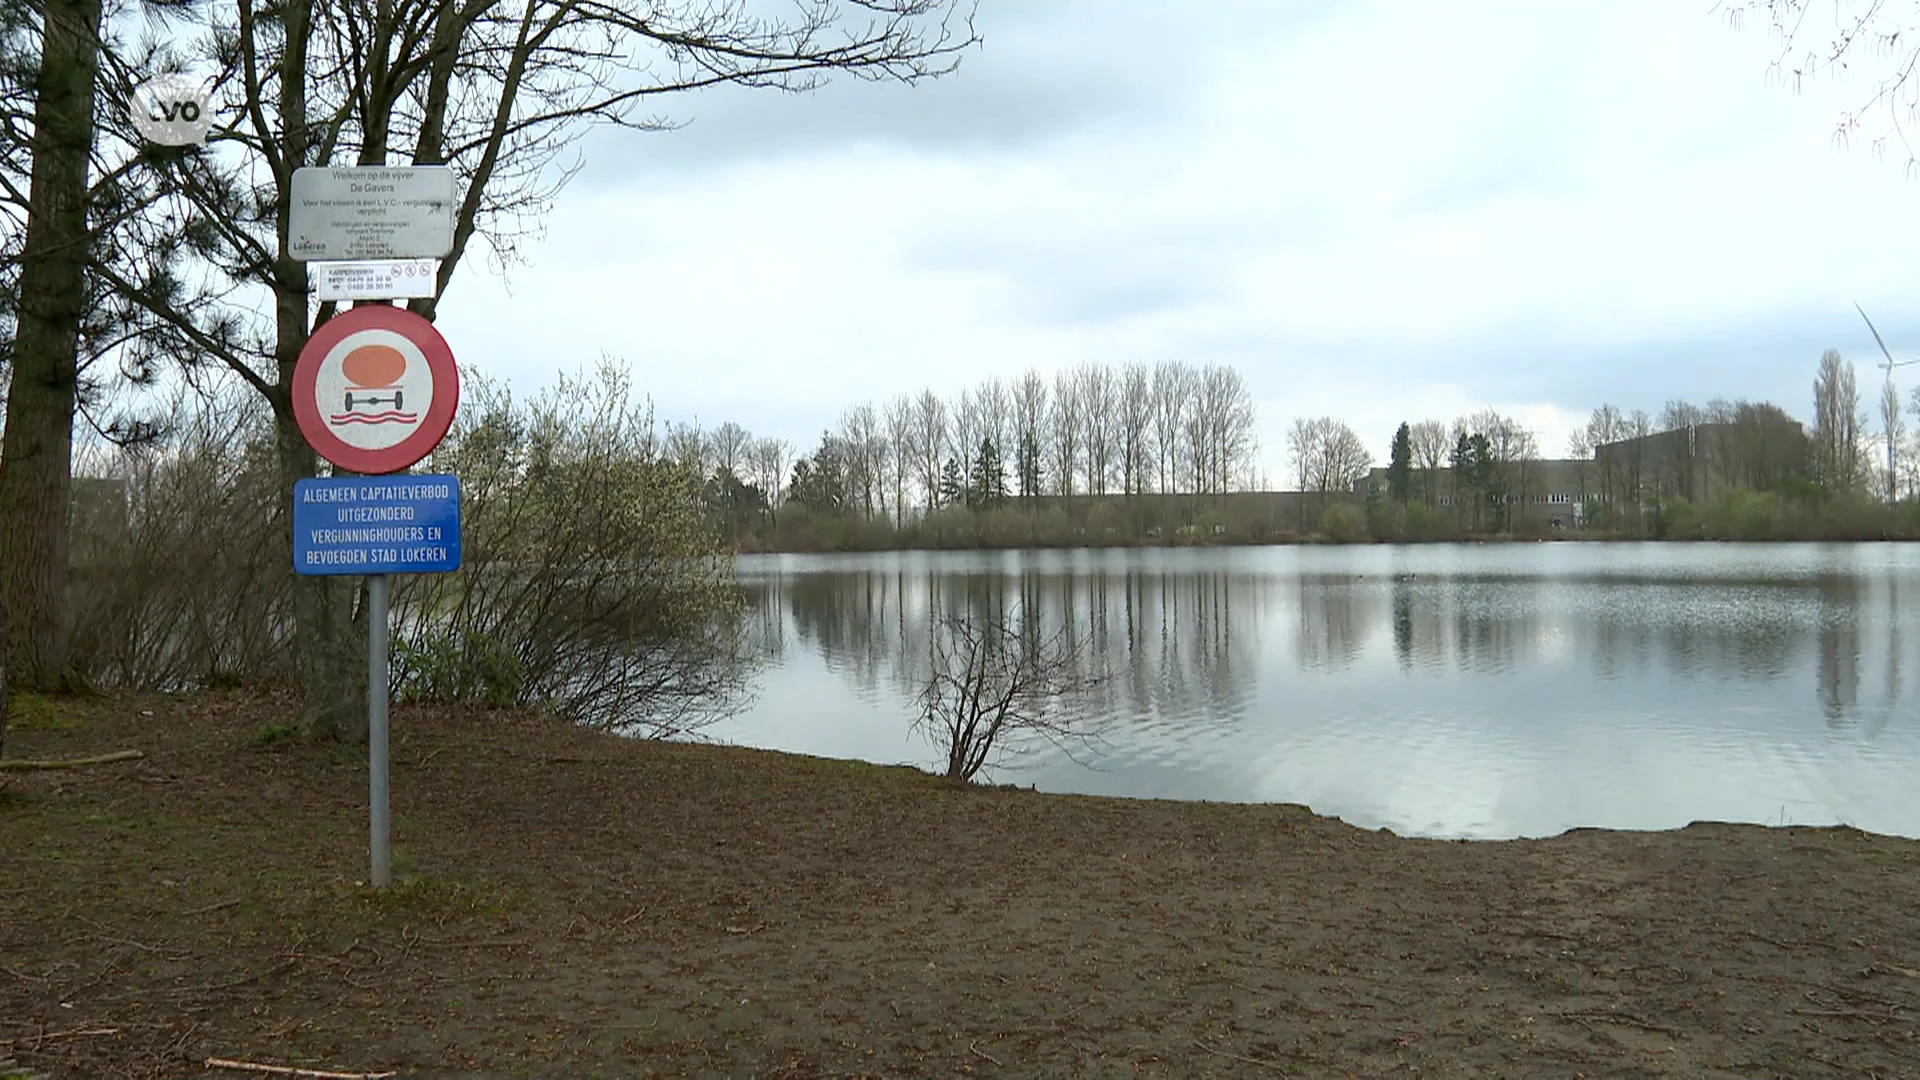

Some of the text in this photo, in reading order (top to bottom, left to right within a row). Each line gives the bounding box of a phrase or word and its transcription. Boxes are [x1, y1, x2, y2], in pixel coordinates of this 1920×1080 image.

[332, 171, 414, 182] Welkom op de vijver
[350, 183, 394, 193] De Gavers
[303, 199, 319, 207] Voor
[320, 199, 331, 207] het
[332, 199, 354, 207] vissen
[363, 199, 376, 207] een
[356, 208, 386, 217] verplicht
[303, 484, 449, 503] ALGEMEEN CAPTATIEVERBOD
[337, 507, 415, 523] UITGEZONDERD
[311, 526, 442, 544] VERGUNNINGHOUDERS EN
[306, 547, 447, 565] BEVOEGDEN STAD LOKEREN
